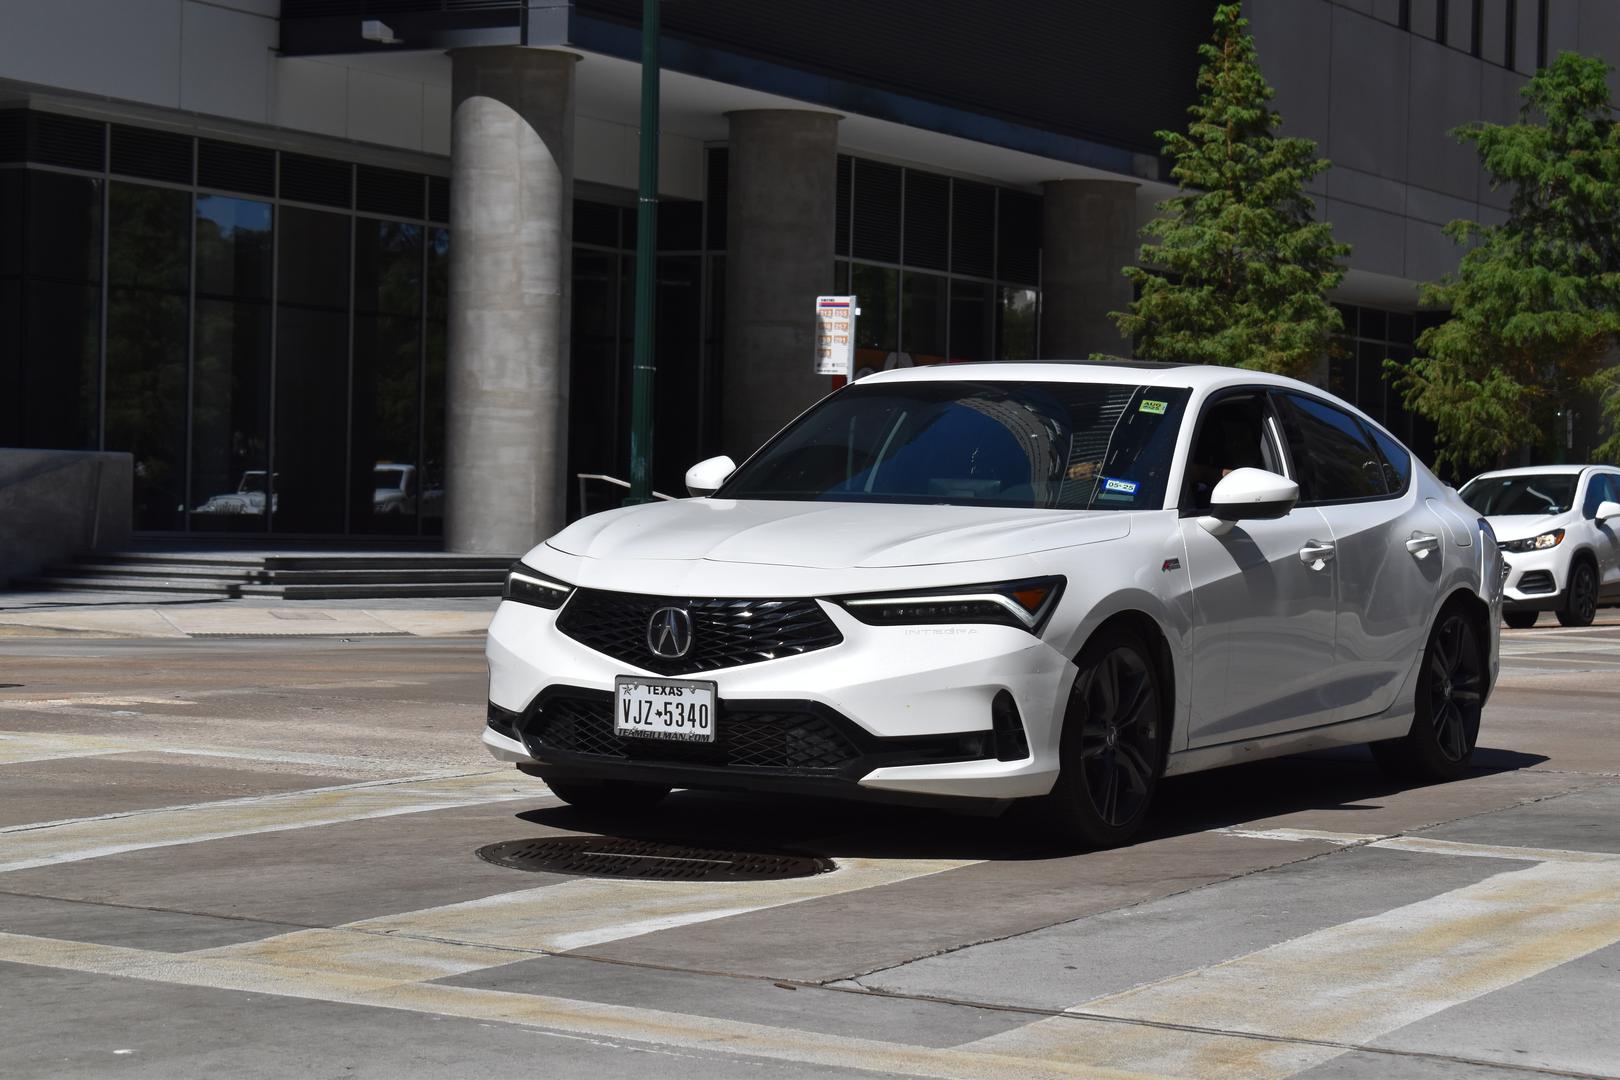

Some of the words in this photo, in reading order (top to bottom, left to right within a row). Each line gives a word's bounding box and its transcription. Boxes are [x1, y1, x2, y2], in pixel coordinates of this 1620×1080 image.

[646, 685, 683, 697] TEXAS
[623, 699, 653, 725] VJZ
[663, 702, 709, 728] 5340
